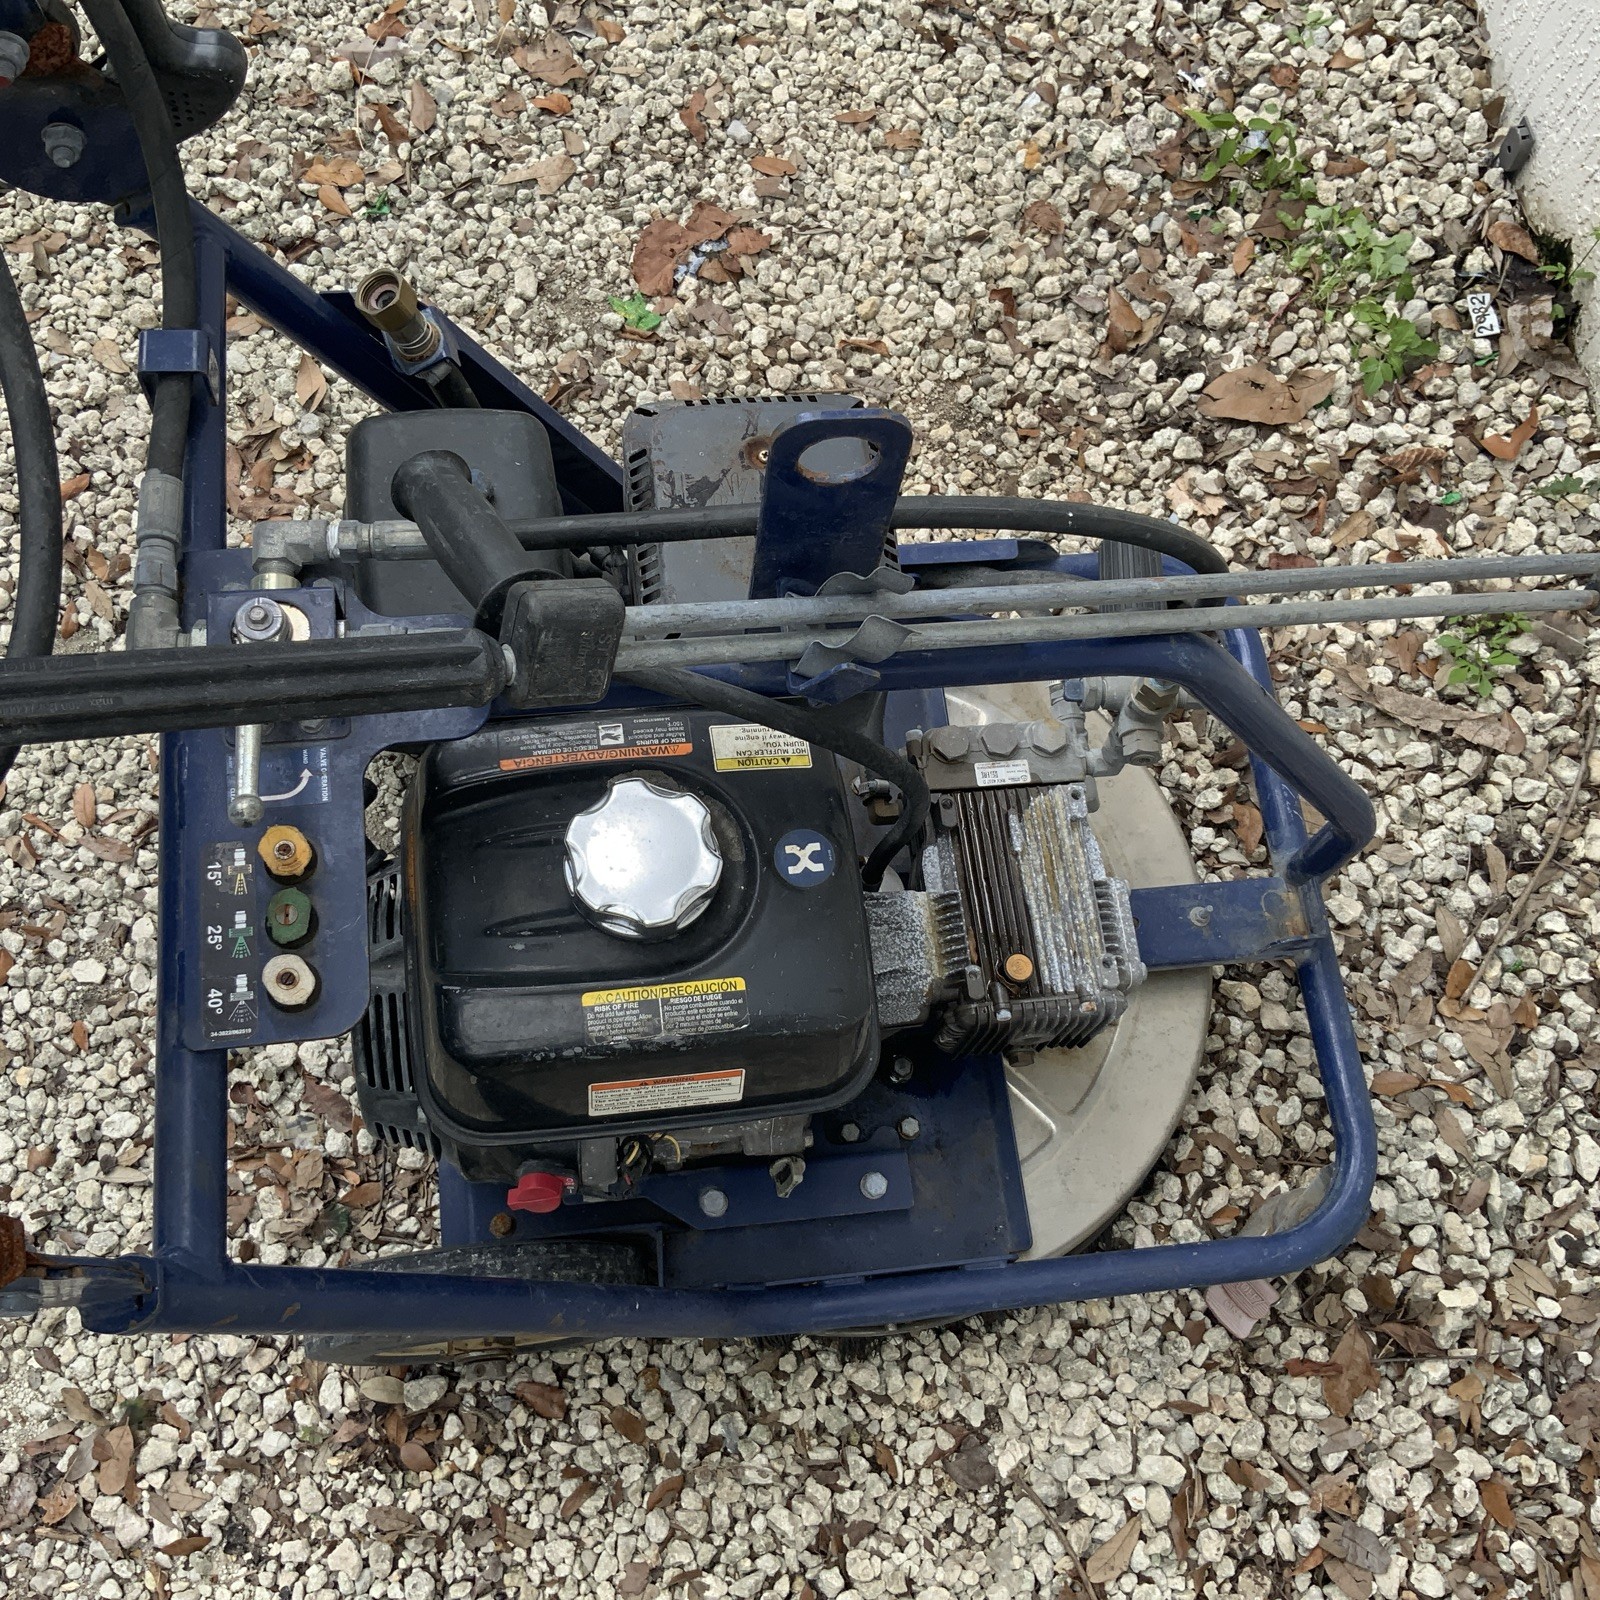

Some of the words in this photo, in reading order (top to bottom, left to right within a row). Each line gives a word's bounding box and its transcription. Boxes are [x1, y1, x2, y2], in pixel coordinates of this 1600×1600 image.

[635, 738, 658, 746] BURNS
[319, 747, 327, 766] VALVE
[532, 747, 561, 755] QUEMAR
[736, 757, 779, 766] CAUTION
[207, 861, 222, 885] 15°
[207, 924, 222, 950] 25°
[606, 977, 737, 1004] CAUTION/PRECAUCIÓN
[207, 988, 222, 1014] 40°
[594, 1004, 611, 1012] RISK
[623, 1001, 638, 1009] FIRE
[672, 1003, 688, 1011] ponga
[688, 1000, 718, 1009] combustible
[718, 997, 737, 1005] cuando
[615, 1008, 625, 1016] fuel
[625, 1007, 639, 1015] when
[652, 1075, 694, 1084] WARNING
